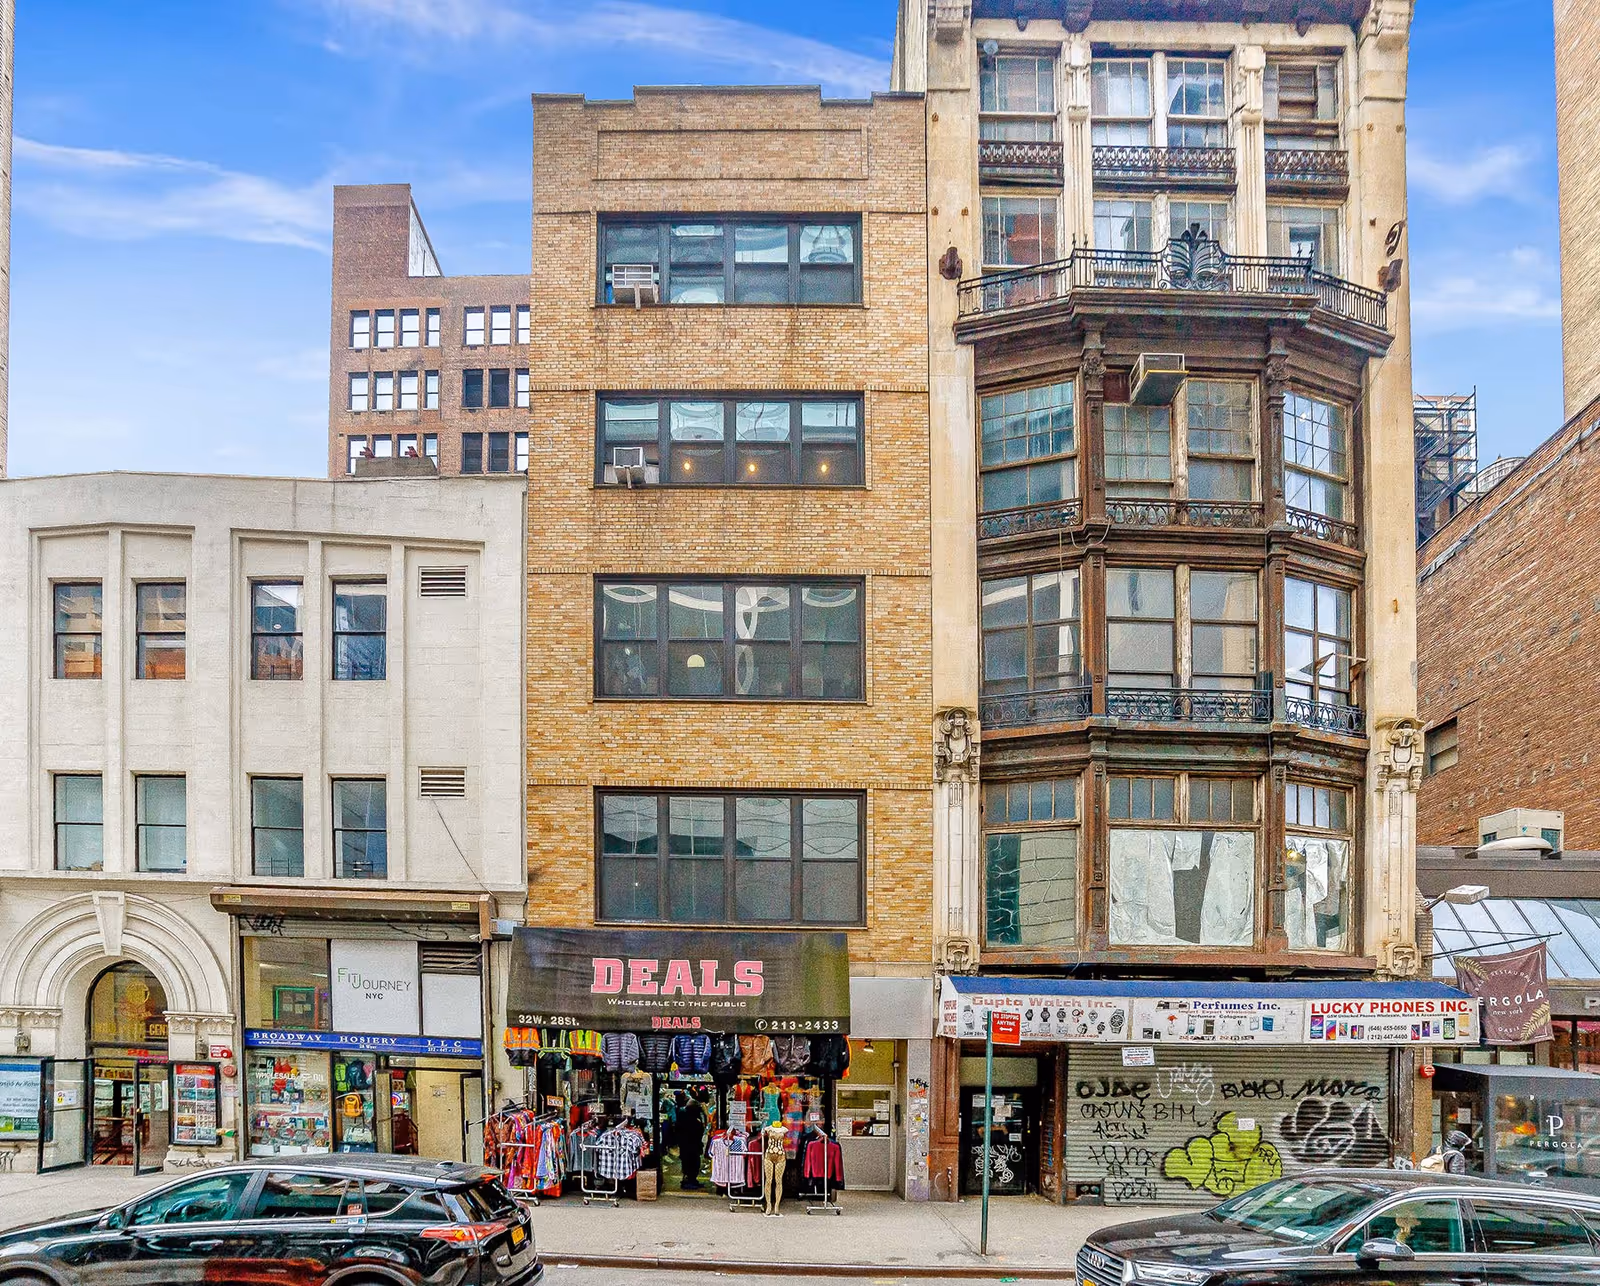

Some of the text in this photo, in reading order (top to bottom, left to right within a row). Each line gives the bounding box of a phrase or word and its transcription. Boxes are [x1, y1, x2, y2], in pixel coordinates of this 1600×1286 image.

[590, 957, 765, 997] DEALS
[607, 998, 670, 1007] WHOLESALE
[972, 996, 1117, 1008] Gupta Watch Inc.
[1478, 988, 1544, 1007] ERGOLA
[1193, 1000, 1281, 1010] Perfumes Inc.
[1311, 1000, 1473, 1014] LUCKY PHONES INC.
[518, 1014, 580, 1027] 32W. 28St.
[651, 1016, 702, 1029] DEALS
[771, 1020, 840, 1031] 213-2433
[253, 1032, 322, 1042] BROADWAY
[340, 1036, 398, 1045] HOSIERY
[1546, 1115, 1564, 1137] P
[1529, 1140, 1583, 1149] PERGOLA
